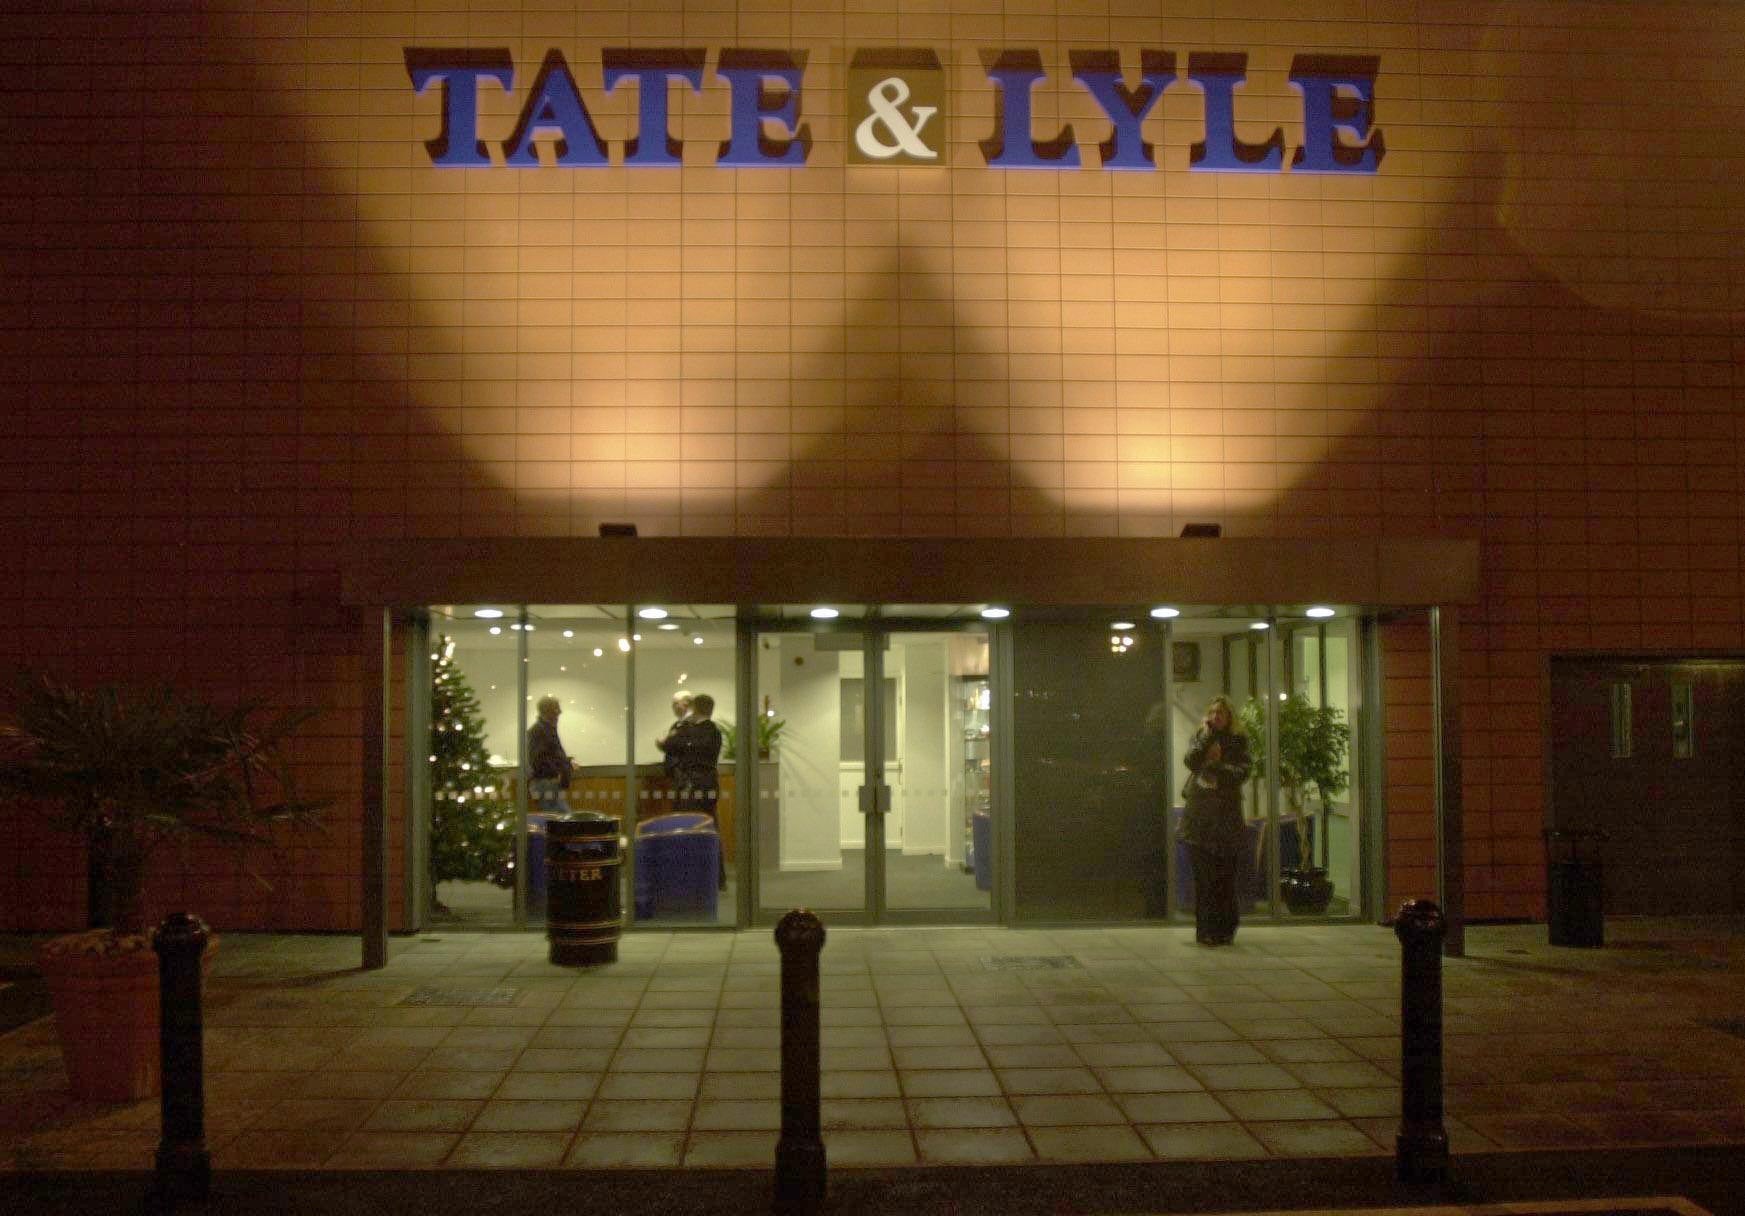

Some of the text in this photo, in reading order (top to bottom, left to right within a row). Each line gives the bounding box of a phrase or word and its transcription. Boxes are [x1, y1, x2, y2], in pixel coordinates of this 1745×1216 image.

[411, 66, 1382, 174] TATE & LYLE
